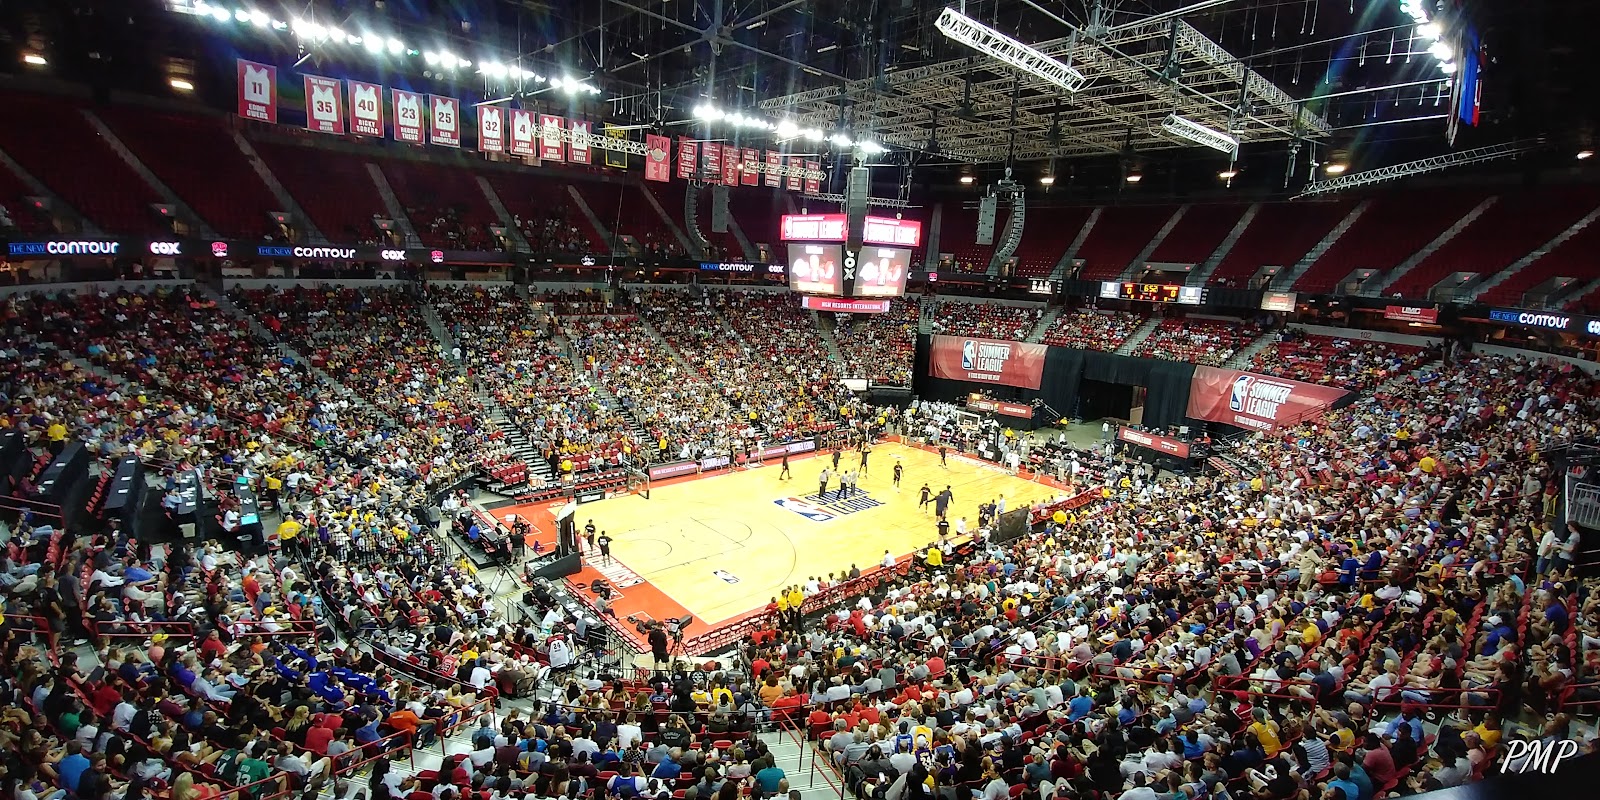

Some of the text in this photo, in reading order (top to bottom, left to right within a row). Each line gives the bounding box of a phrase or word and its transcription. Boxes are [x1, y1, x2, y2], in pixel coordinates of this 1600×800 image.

[252, 82, 262, 95] 11
[317, 100, 333, 113] 35
[358, 99, 374, 112] 40
[402, 107, 416, 119] 23
[438, 112, 452, 124] 25
[485, 120, 498, 132] 32
[519, 124, 526, 134] 4
[9, 244, 25, 253] THE
[26, 244, 45, 253] NEW
[274, 248, 292, 256] NEW
[1502, 312, 1518, 321] NEW
[1360, 331, 1372, 339] 102
[978, 344, 1010, 360] SUMMER
[977, 357, 1004, 372] LEAGUE
[1249, 382, 1291, 404] SUMMER
[1246, 396, 1279, 420] LEAGUE
[826, 495, 886, 515] LEAGUE
